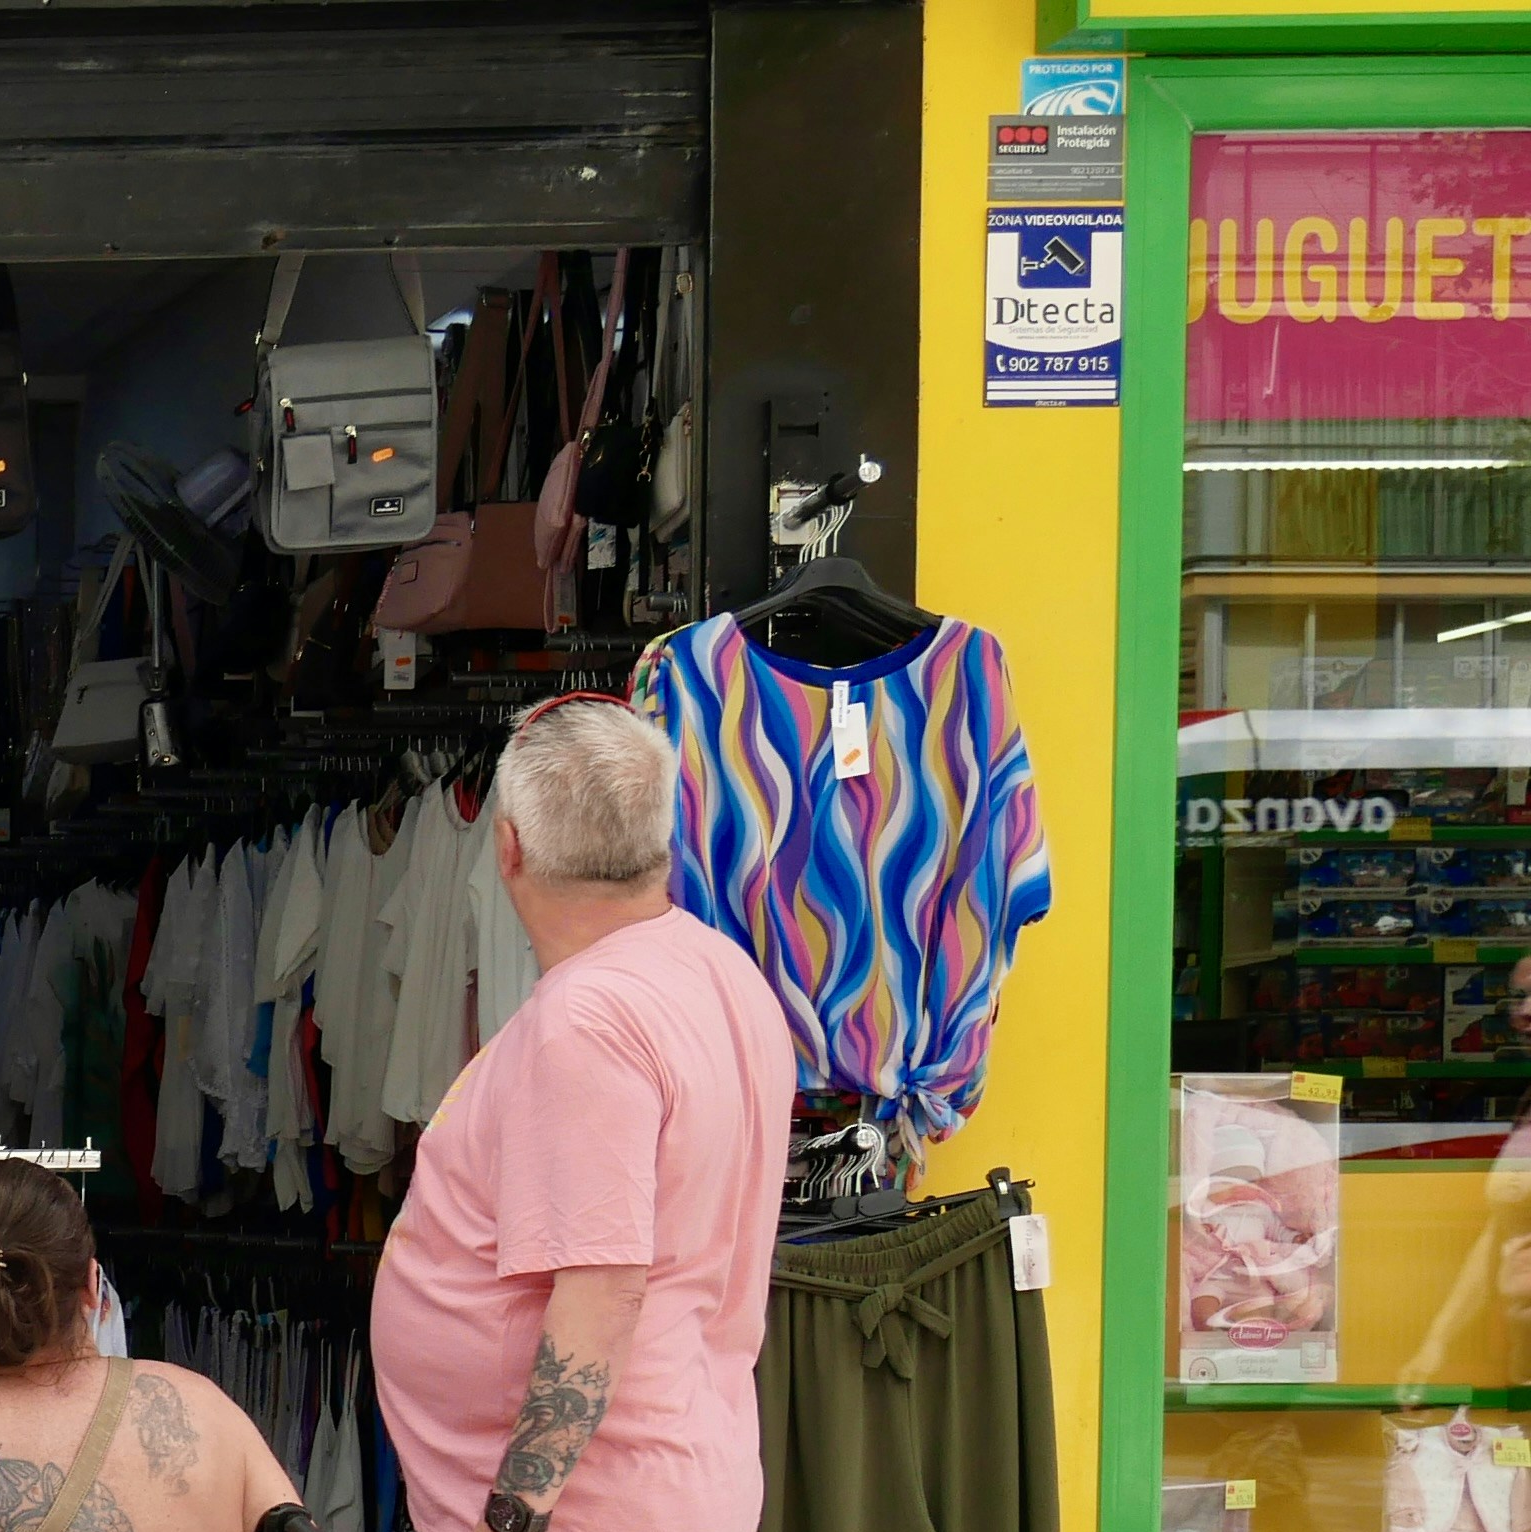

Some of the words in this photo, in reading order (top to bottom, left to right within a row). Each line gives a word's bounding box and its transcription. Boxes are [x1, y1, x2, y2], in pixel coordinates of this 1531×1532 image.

[1029, 65, 1089, 74] PROTEGIDO
[1092, 64, 1114, 73] POR
[1056, 125, 1117, 136] Instalación
[998, 145, 1047, 154] SECURITAS
[1056, 137, 1110, 150] Protegida
[988, 215, 1023, 227] ZONA
[1025, 214, 1123, 226] VIDEOVIGILADA
[1008, 356, 1042, 372] 902
[1044, 356, 1074, 371] 787
[1078, 356, 1109, 371] 915
